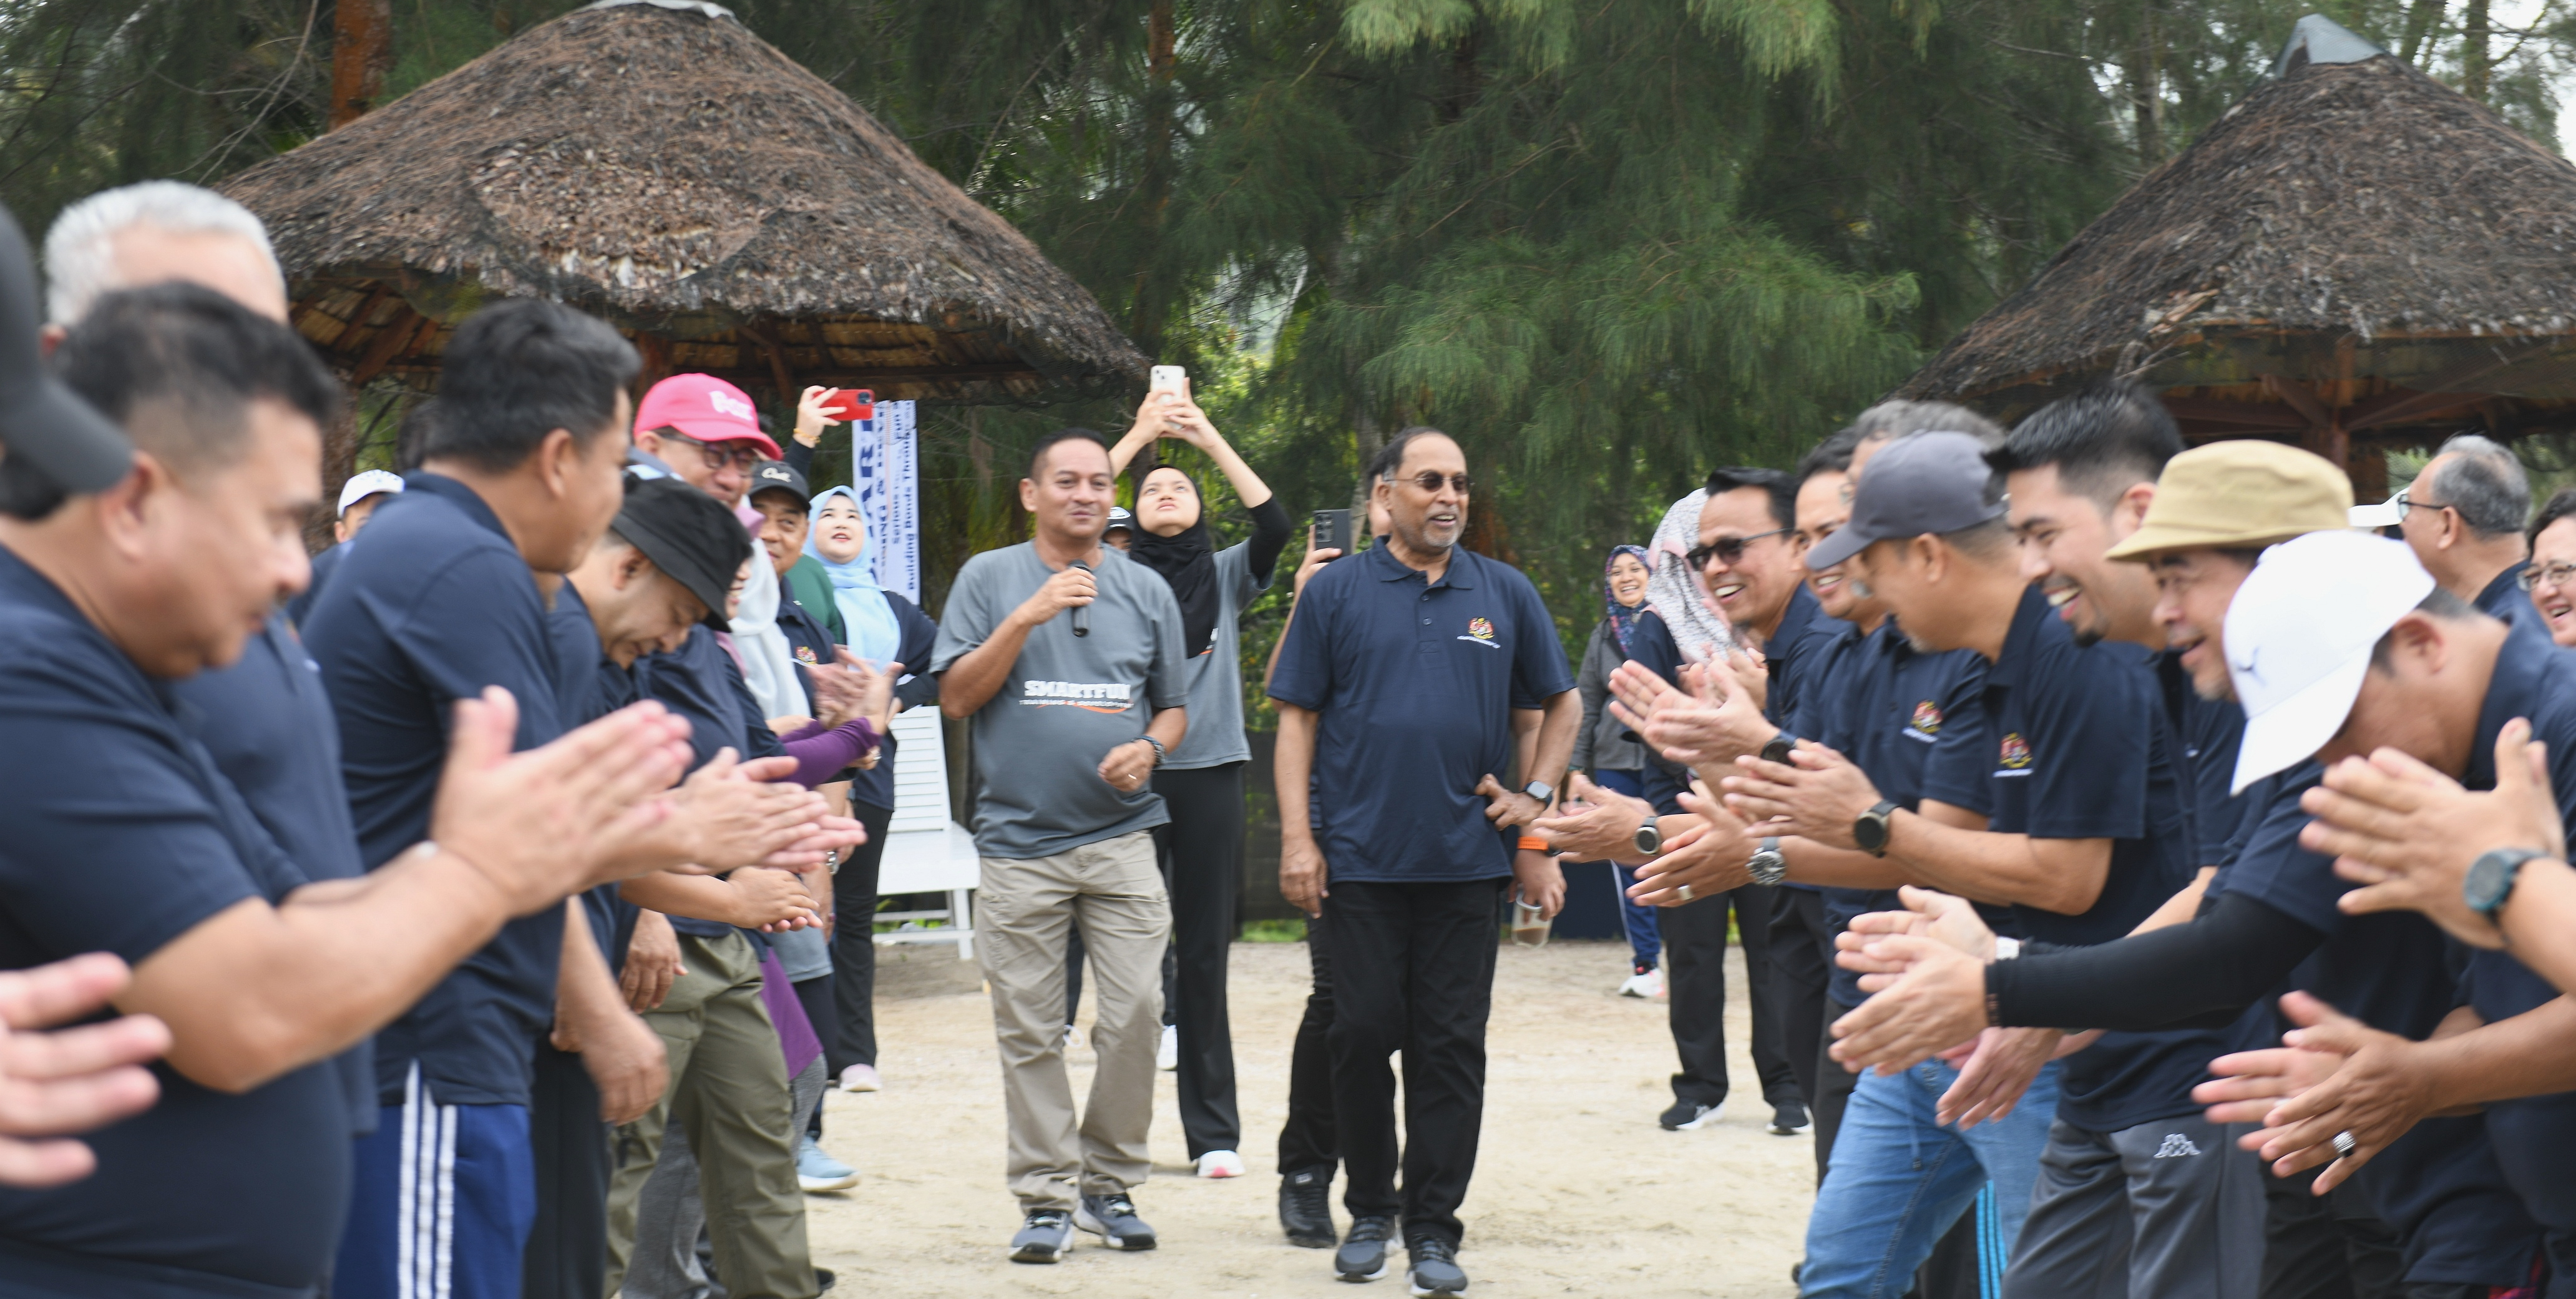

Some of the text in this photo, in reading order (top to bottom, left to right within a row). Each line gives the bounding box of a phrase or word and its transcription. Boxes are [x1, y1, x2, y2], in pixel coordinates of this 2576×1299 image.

[904, 486, 913, 529] Bonds
[904, 533, 918, 591] Building
[1024, 680, 1131, 700] SMARTFUN
